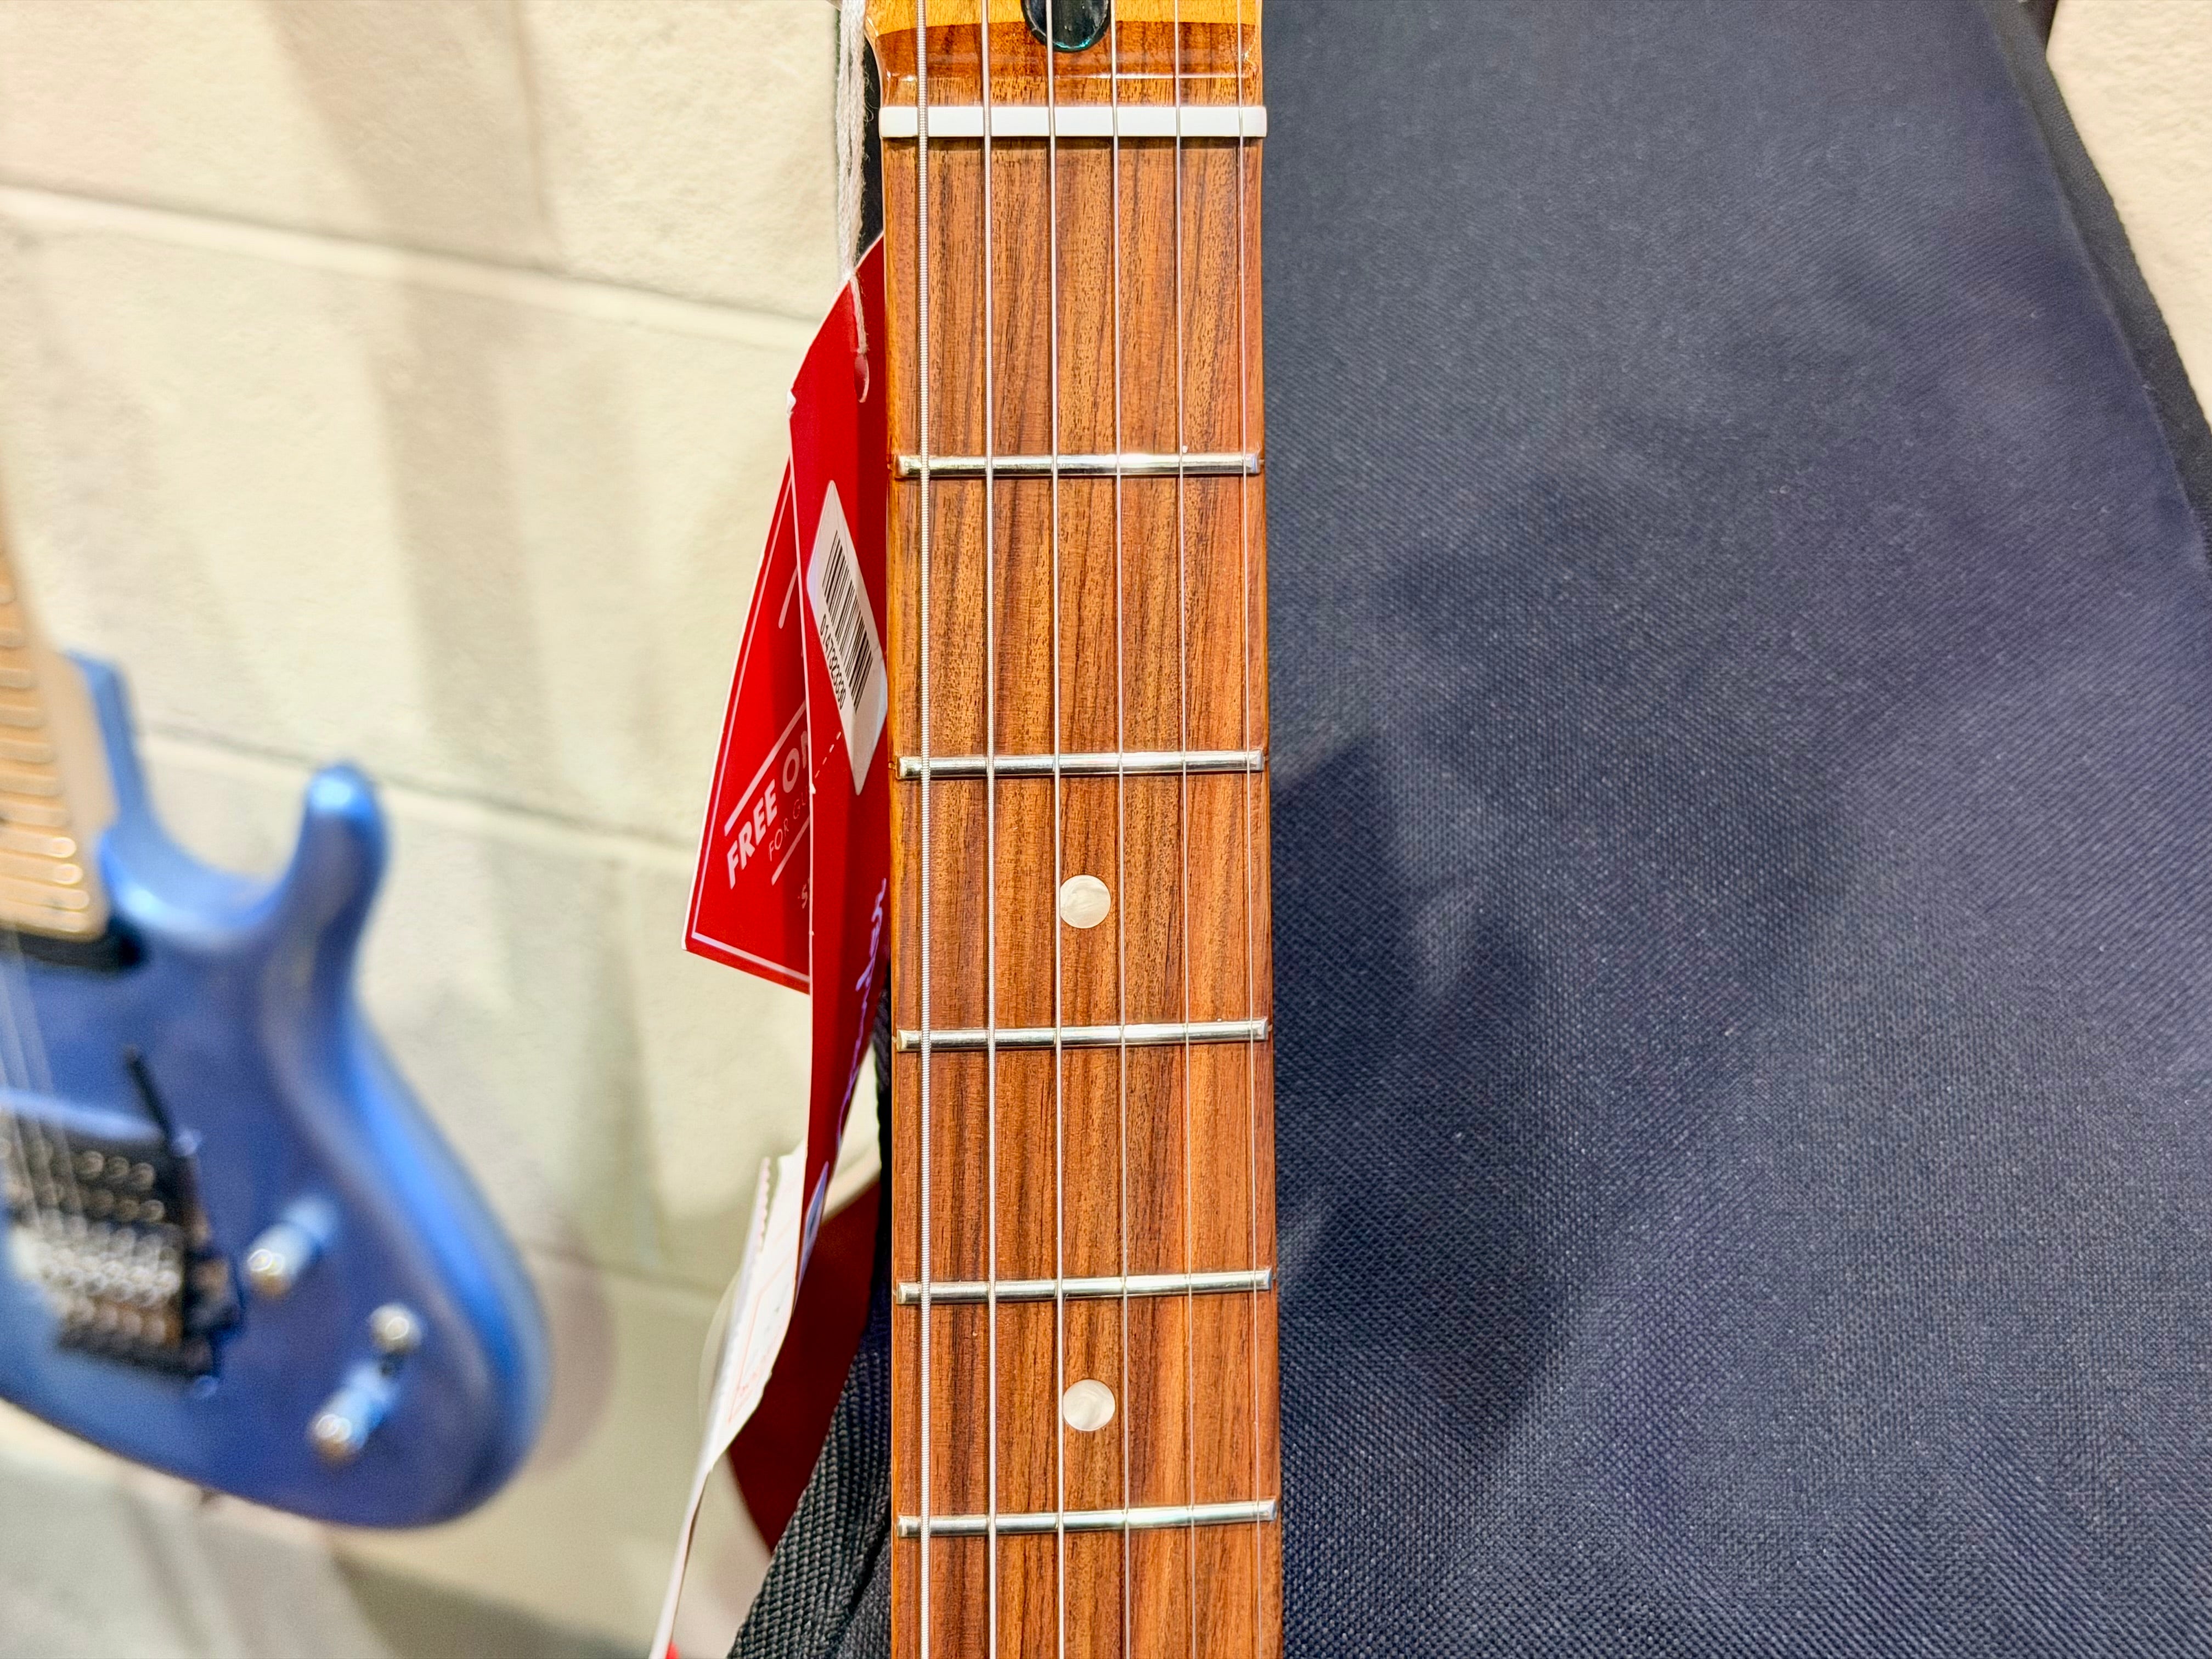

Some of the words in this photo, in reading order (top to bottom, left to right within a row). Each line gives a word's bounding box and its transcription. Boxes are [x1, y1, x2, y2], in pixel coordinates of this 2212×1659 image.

[820, 613, 847, 710] 0147323330
[727, 778, 777, 890] FREE
[769, 818, 789, 861] FOR
